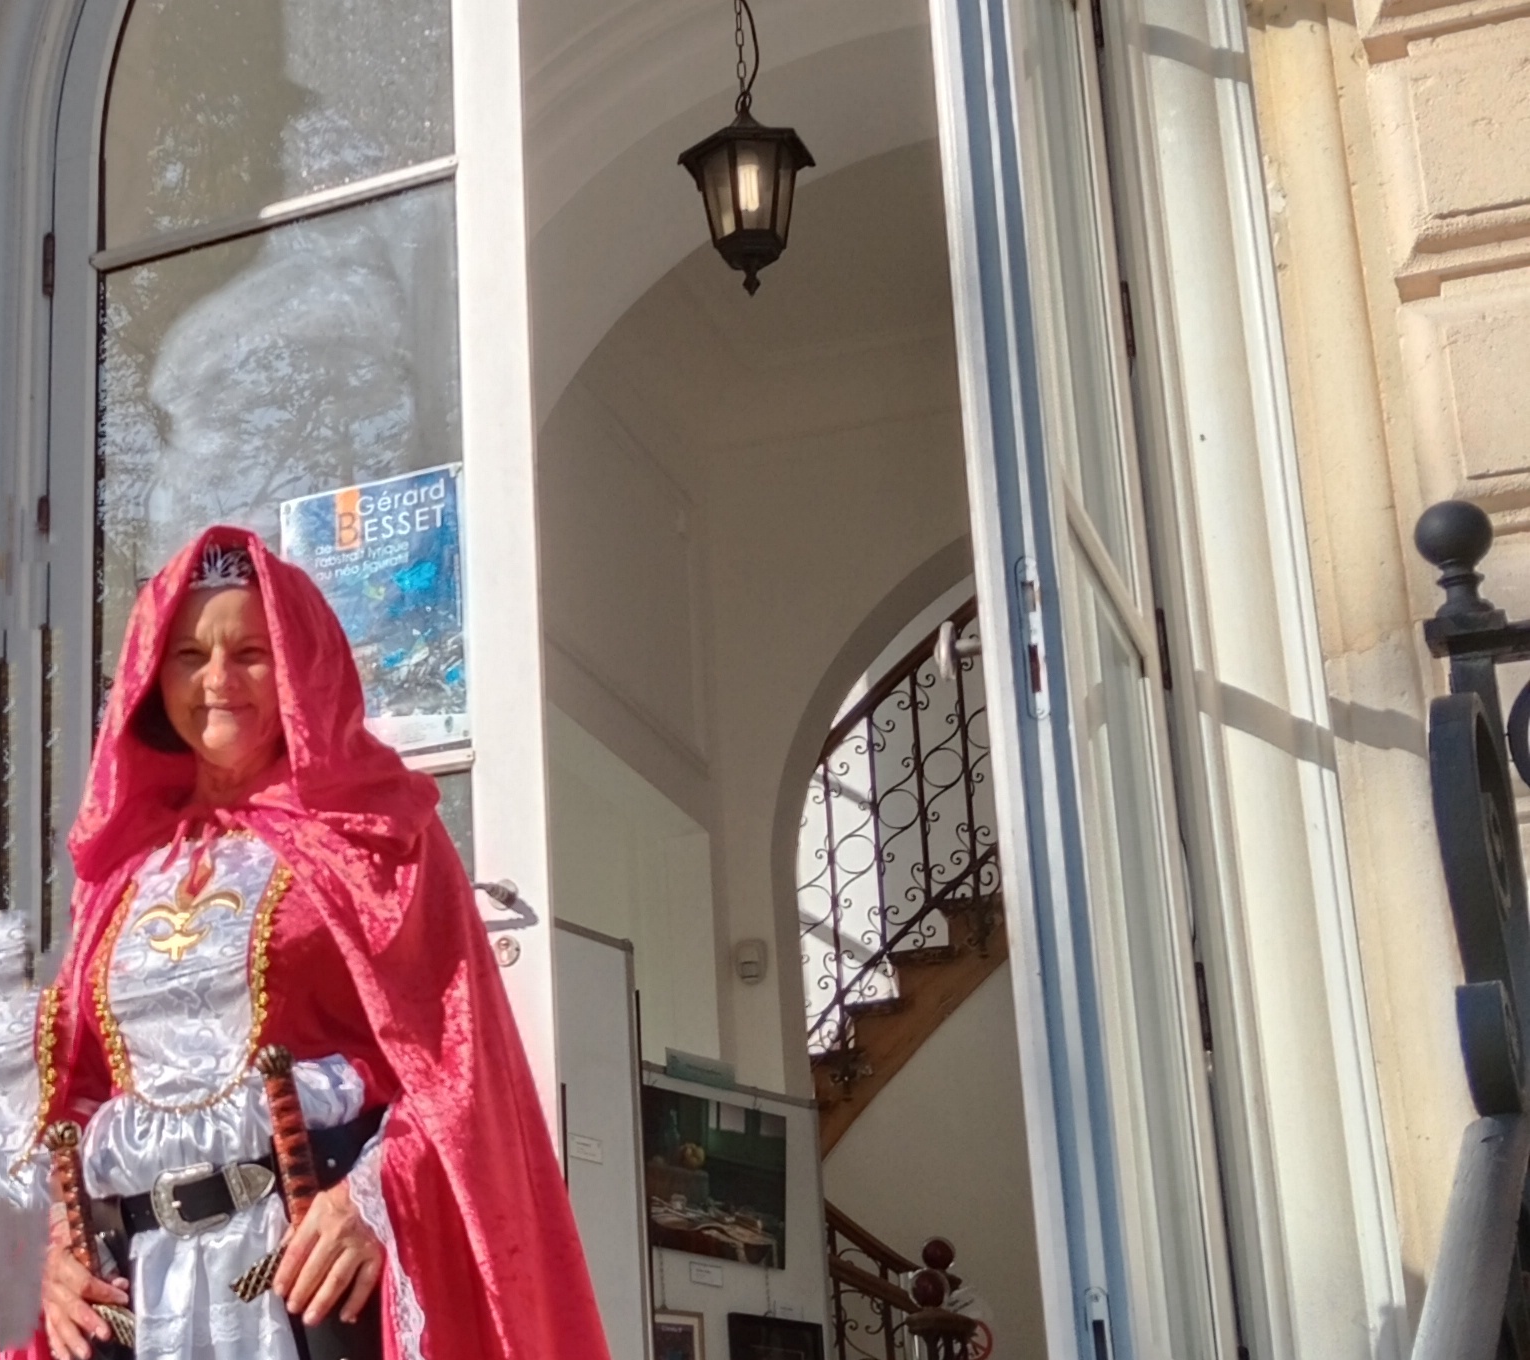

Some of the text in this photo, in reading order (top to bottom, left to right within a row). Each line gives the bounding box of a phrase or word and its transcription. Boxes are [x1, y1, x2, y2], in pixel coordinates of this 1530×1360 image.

[355, 478, 445, 516] Gérard
[338, 503, 445, 547] BESSET
[315, 544, 332, 556] de
